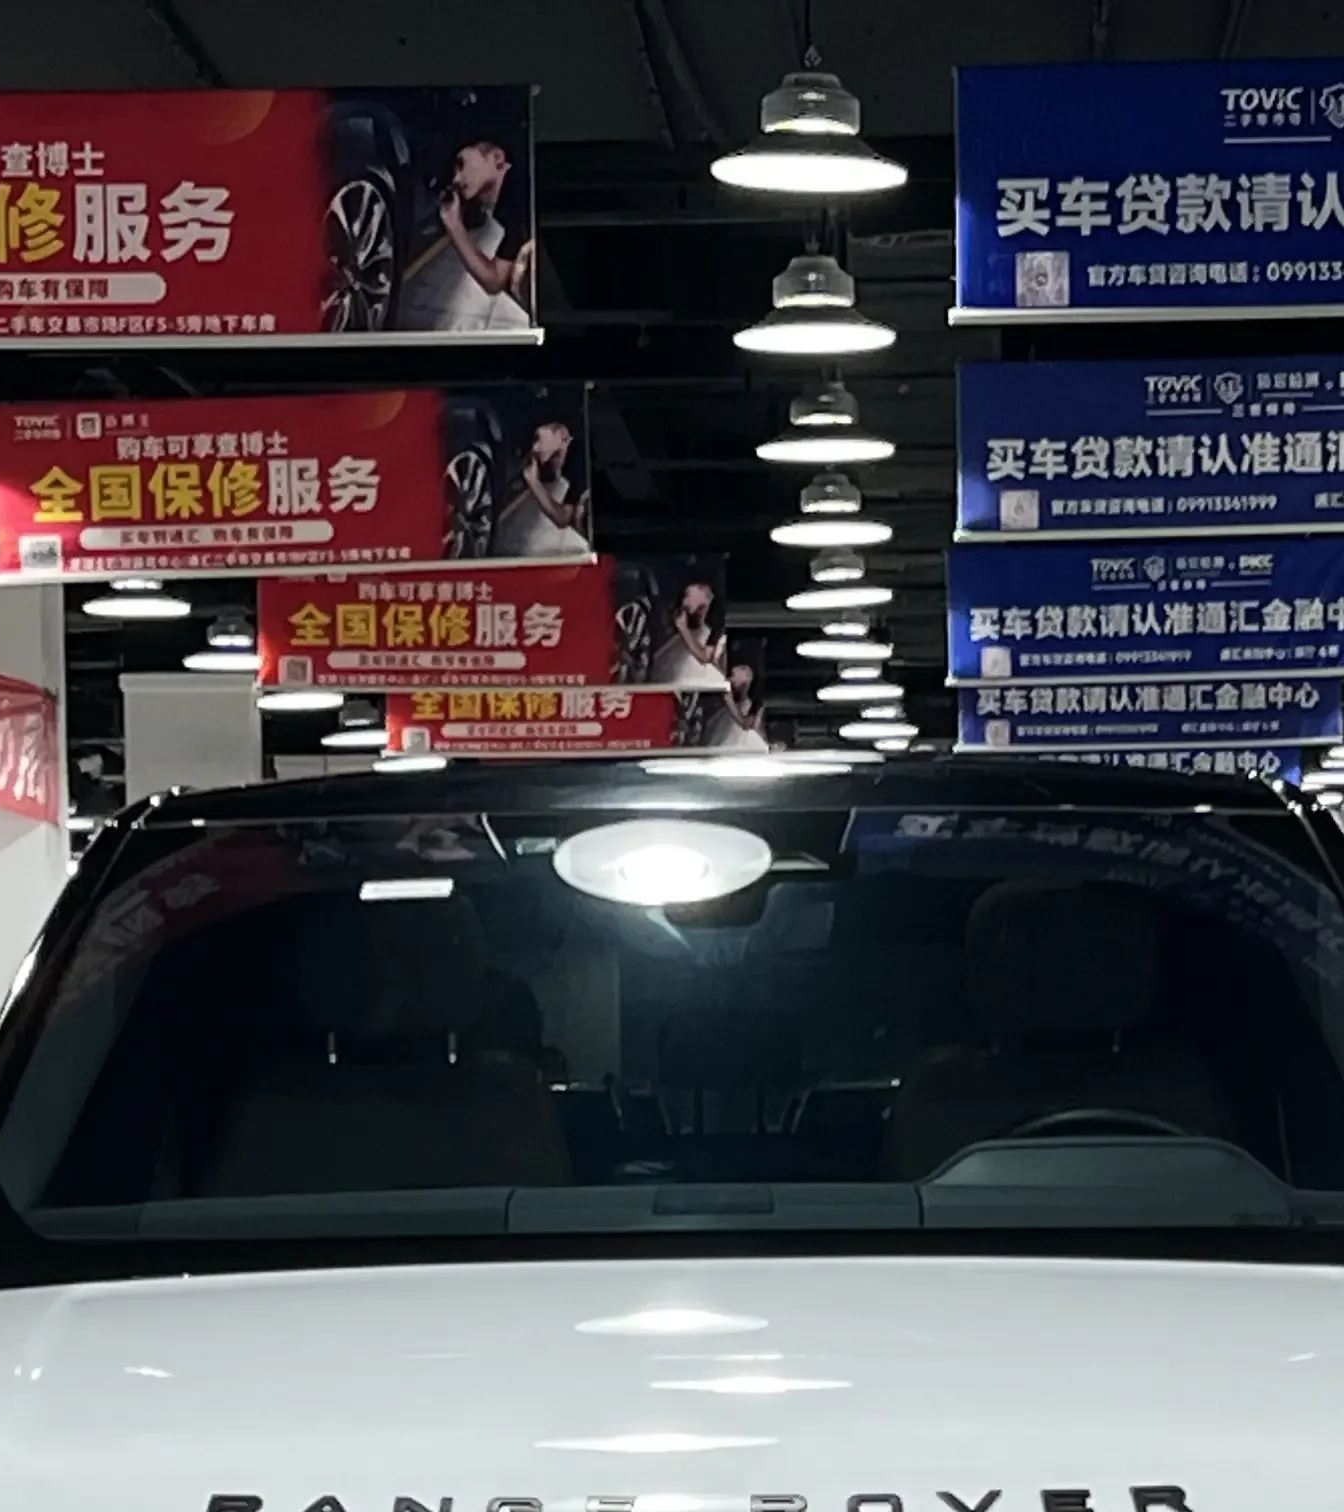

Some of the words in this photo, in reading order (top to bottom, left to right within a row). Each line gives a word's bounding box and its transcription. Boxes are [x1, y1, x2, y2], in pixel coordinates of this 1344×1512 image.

[1220, 86, 1304, 112] TOVIC
[116, 431, 289, 461] 购车可享查博士
[29, 455, 381, 523] 全国保修服务
[287, 601, 565, 648] 全国保修服务
[411, 689, 634, 720] 全国保修服务
[977, 681, 1320, 716] 买车贷款请认准通汇金融中心
